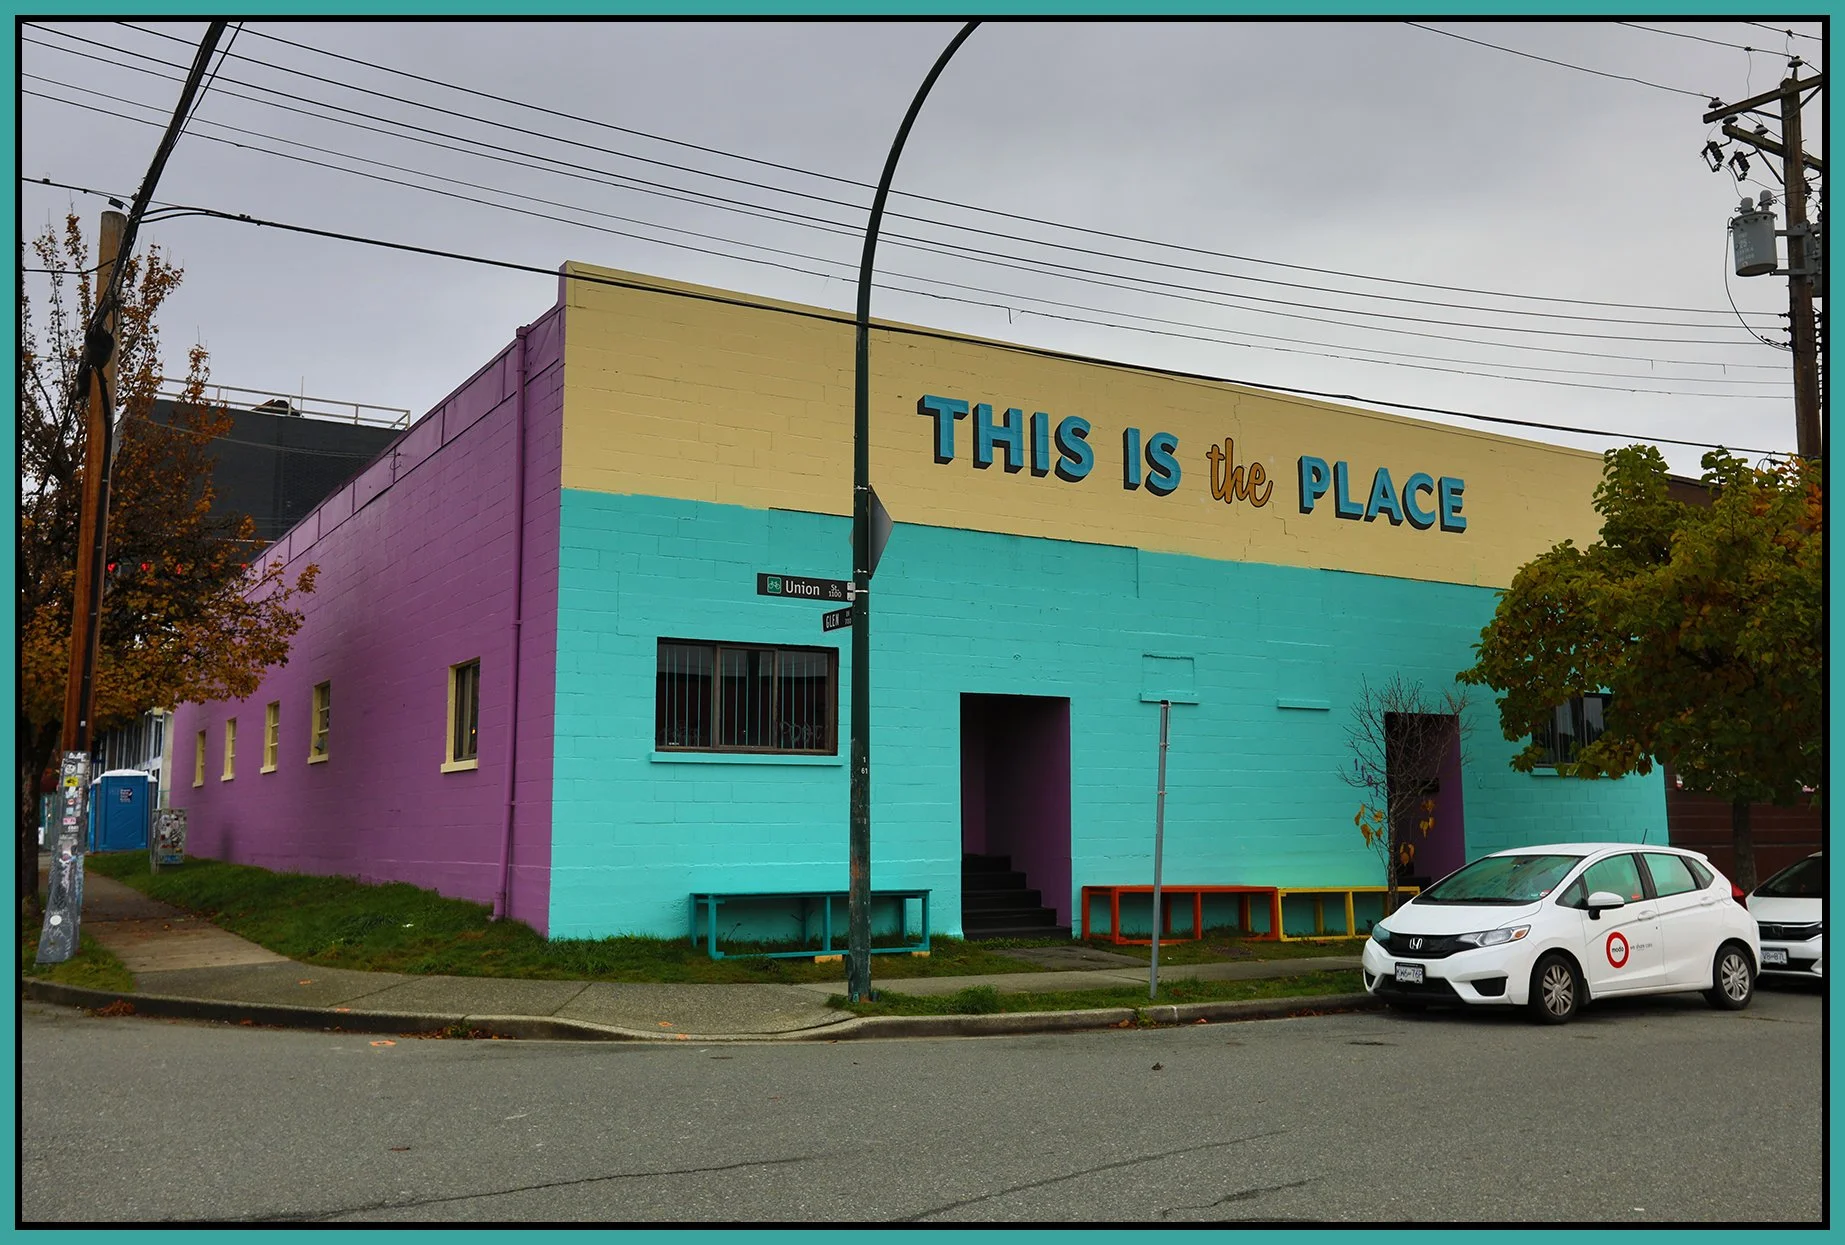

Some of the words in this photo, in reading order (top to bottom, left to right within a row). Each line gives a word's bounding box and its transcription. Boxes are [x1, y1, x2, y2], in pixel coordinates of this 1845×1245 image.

[917, 394, 1095, 483] THIS
[1122, 427, 1182, 497] IS
[1205, 437, 1273, 508] the
[1297, 455, 1467, 534] PLACE
[785, 580, 820, 596] Union
[828, 590, 842, 598] 1100
[825, 613, 840, 629] GLEN
[860, 767, 868, 775] 61
